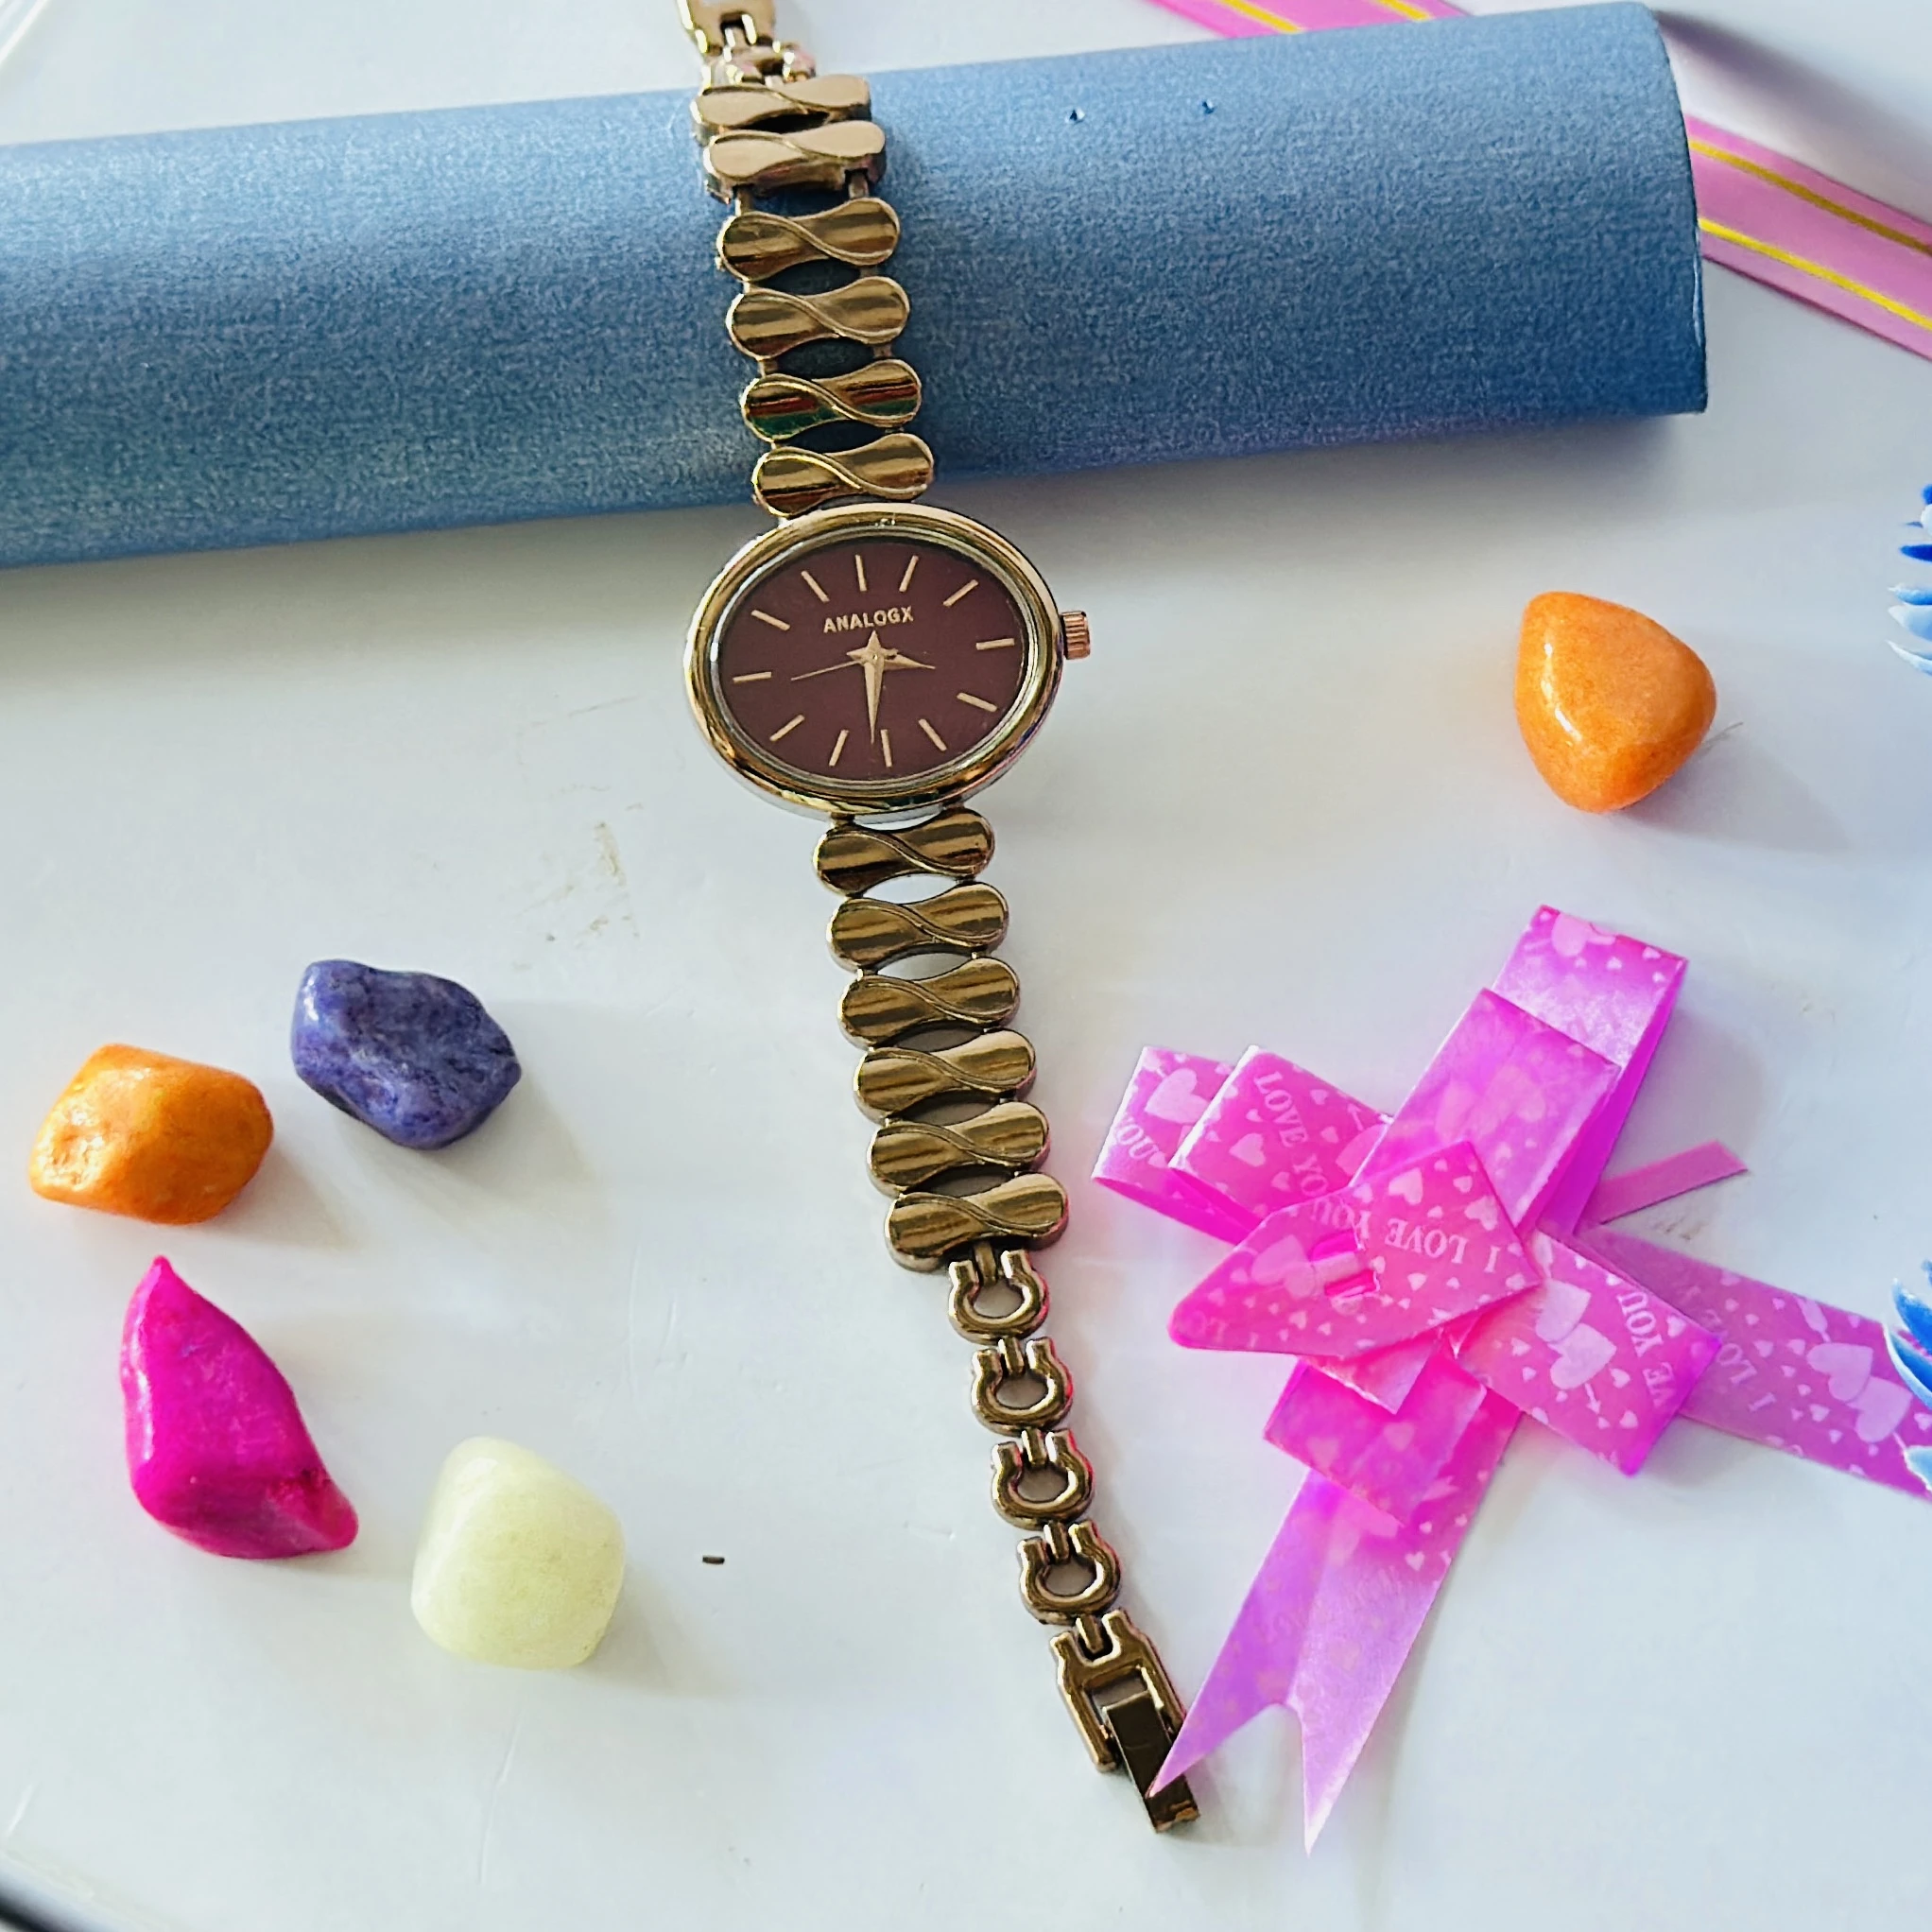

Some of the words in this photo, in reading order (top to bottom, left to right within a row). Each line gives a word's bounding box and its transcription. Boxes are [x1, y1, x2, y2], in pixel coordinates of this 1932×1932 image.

[823, 606, 914, 633] ANALOGX
[1253, 1070, 1309, 1147] LOVE
[1292, 1153, 1329, 1198] YO
[1384, 1217, 1470, 1265] LOVE
[1482, 1244, 1503, 1274] I
[1615, 1290, 1665, 1358] YOU
